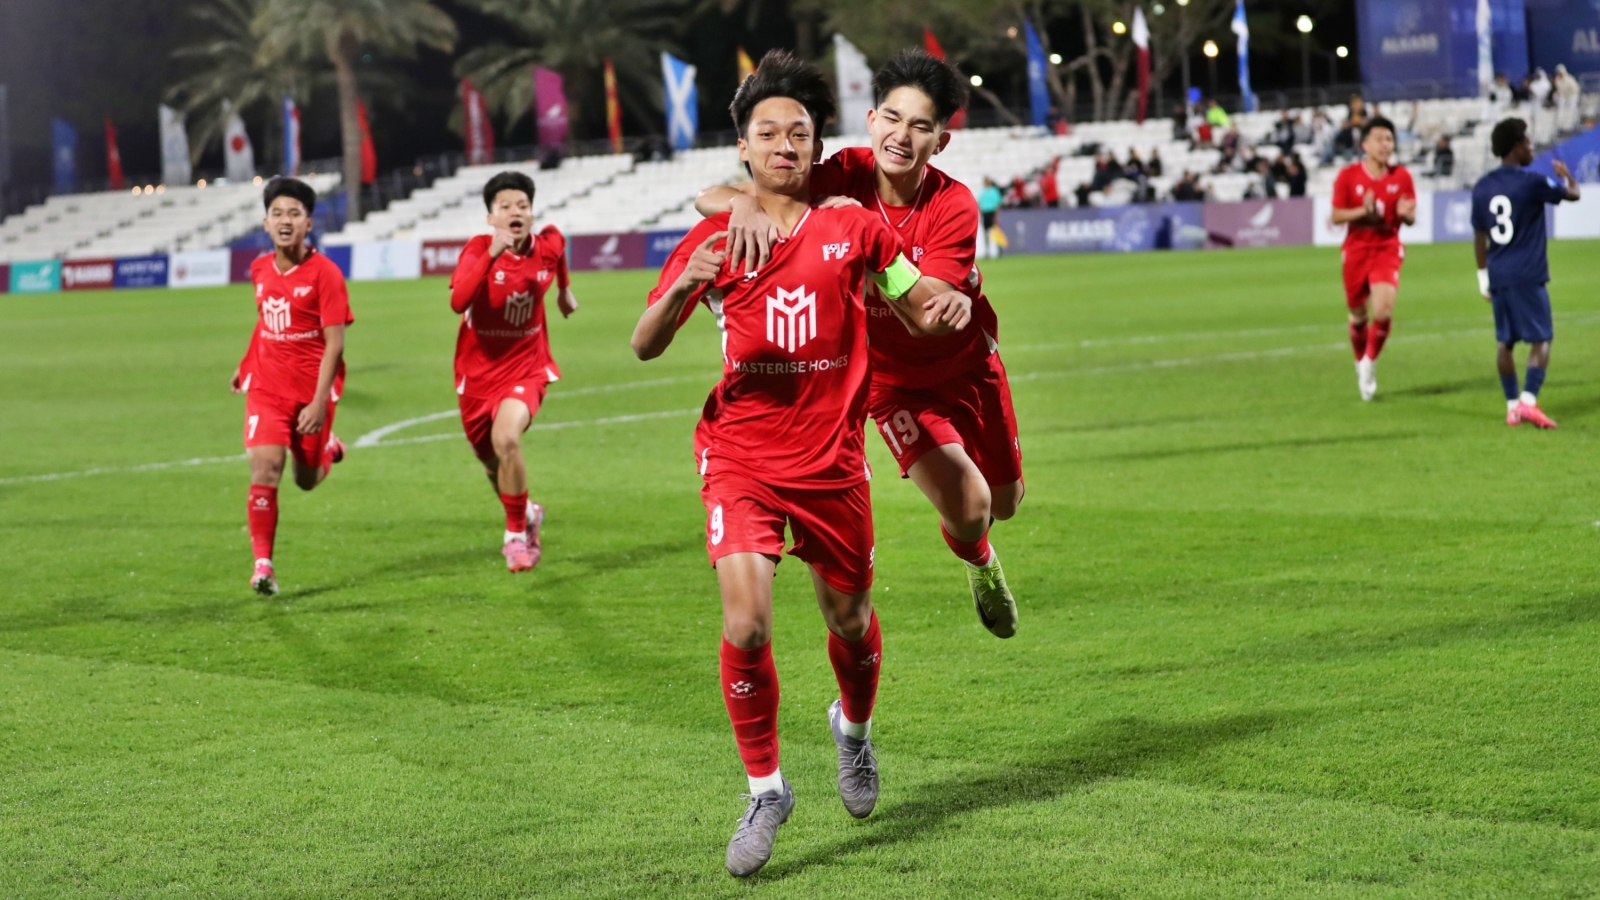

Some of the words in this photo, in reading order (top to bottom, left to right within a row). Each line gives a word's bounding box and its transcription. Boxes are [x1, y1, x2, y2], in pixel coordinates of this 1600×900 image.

[1047, 219, 1115, 241] ALKASS
[1489, 195, 1514, 245] 3
[732, 359, 807, 374] MASTERISE
[808, 354, 849, 372] HOMES
[248, 415, 259, 439] 7
[882, 409, 920, 455] 19
[710, 505, 724, 546] 9
